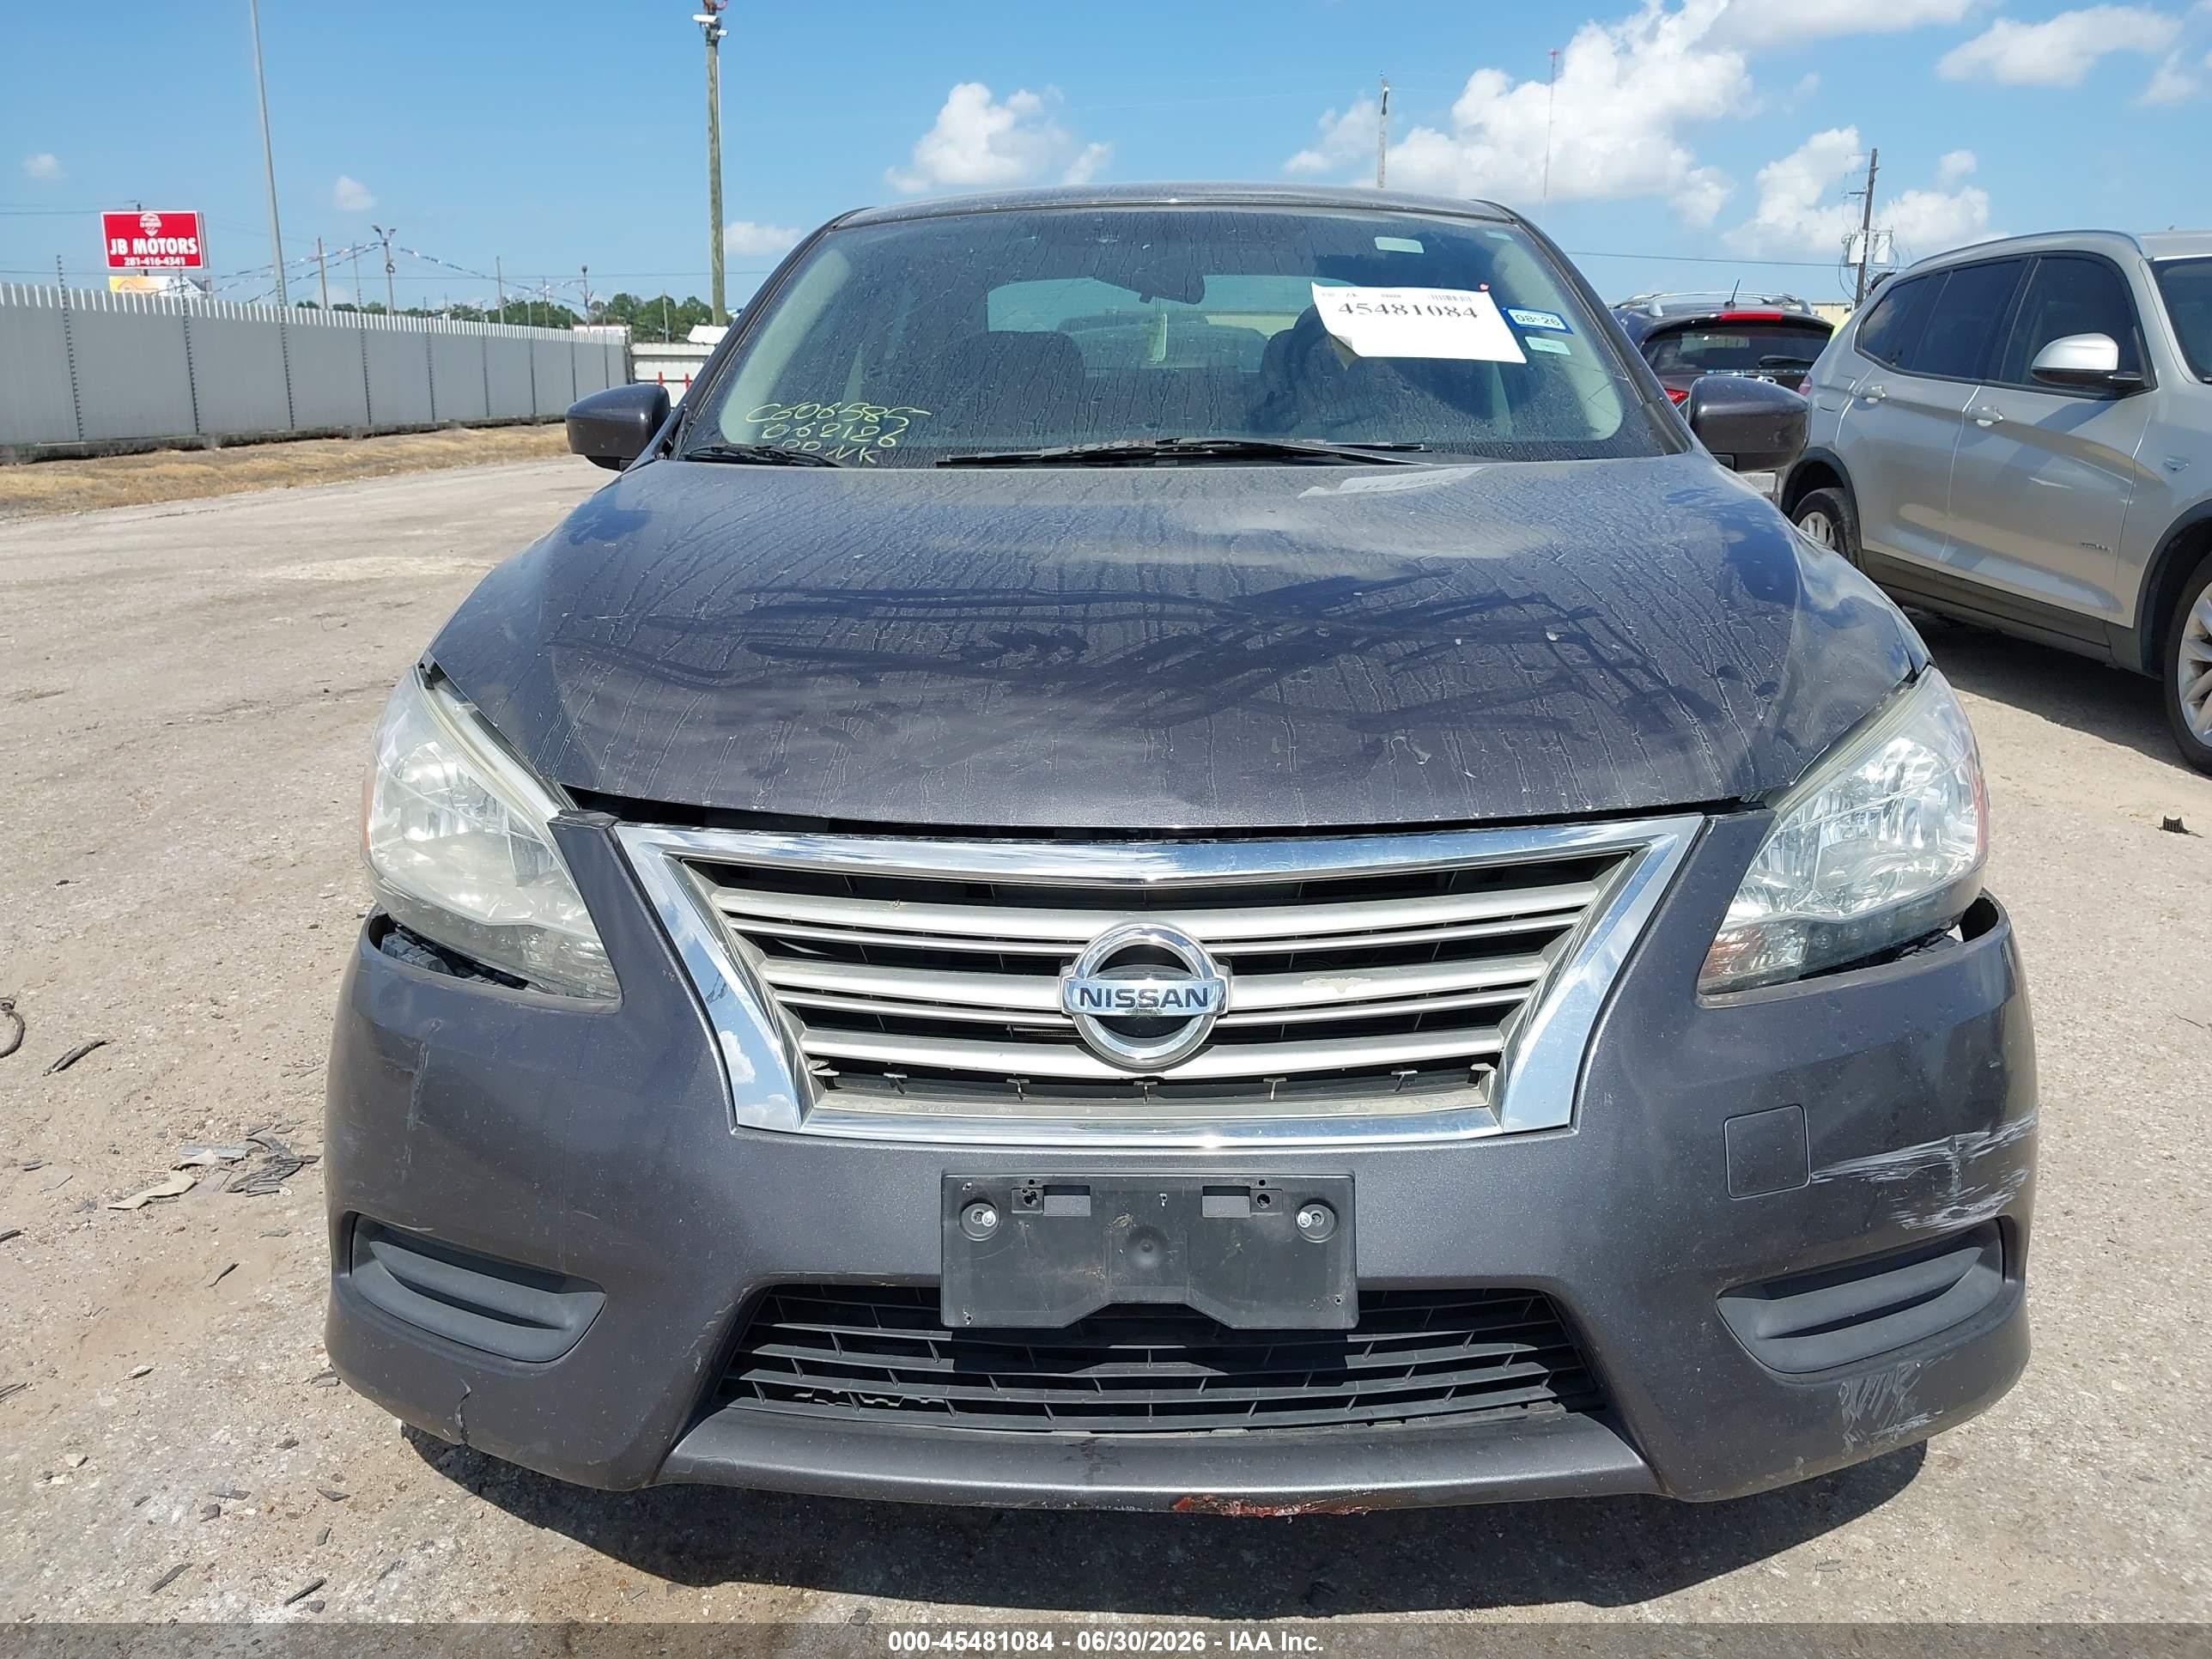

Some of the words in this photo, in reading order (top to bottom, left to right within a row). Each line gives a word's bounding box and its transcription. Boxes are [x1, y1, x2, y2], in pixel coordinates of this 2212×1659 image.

[110, 239, 128, 255] JB
[133, 238, 198, 254] MOTORS
[124, 257, 185, 266] 281-416-4341
[1338, 302, 1478, 318] 45481084
[1079, 988, 1208, 1008] NISSAN
